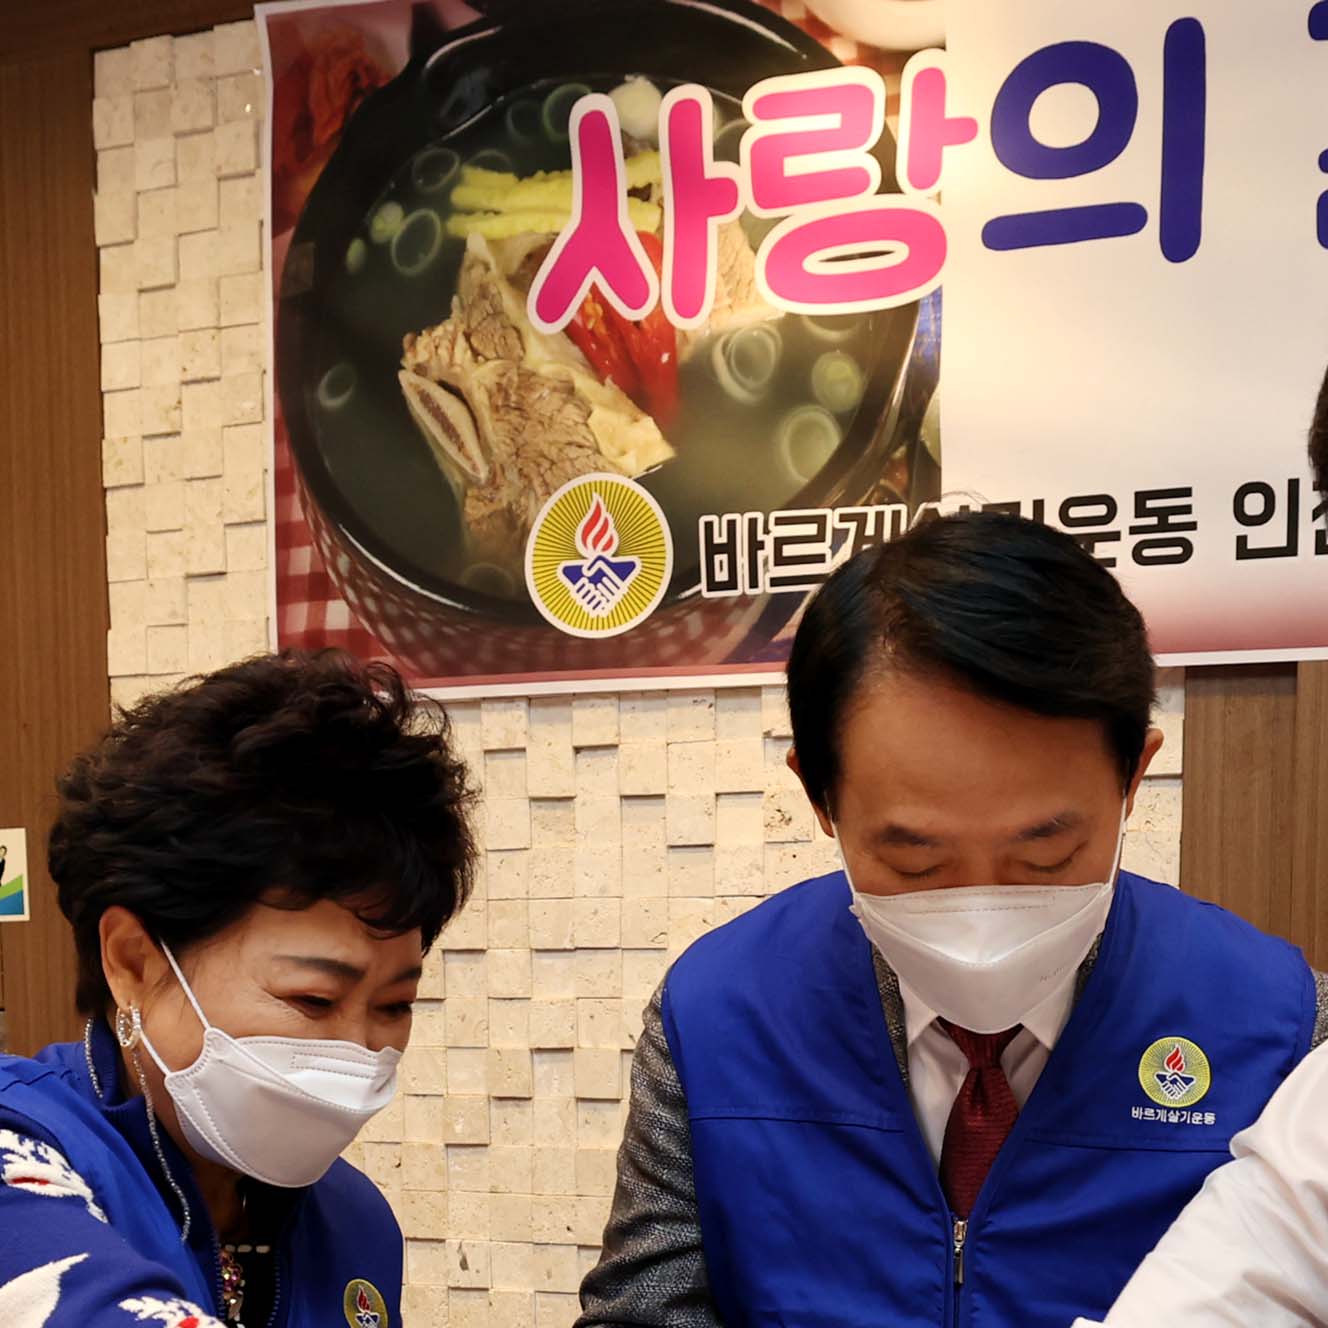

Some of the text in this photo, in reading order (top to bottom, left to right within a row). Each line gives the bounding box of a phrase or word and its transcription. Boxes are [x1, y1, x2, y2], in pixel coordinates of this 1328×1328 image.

[534, 17, 1205, 324] 사랑의
[704, 486, 1198, 592] 바르게운동
[1130, 1106, 1217, 1126] 바르게살기운동
